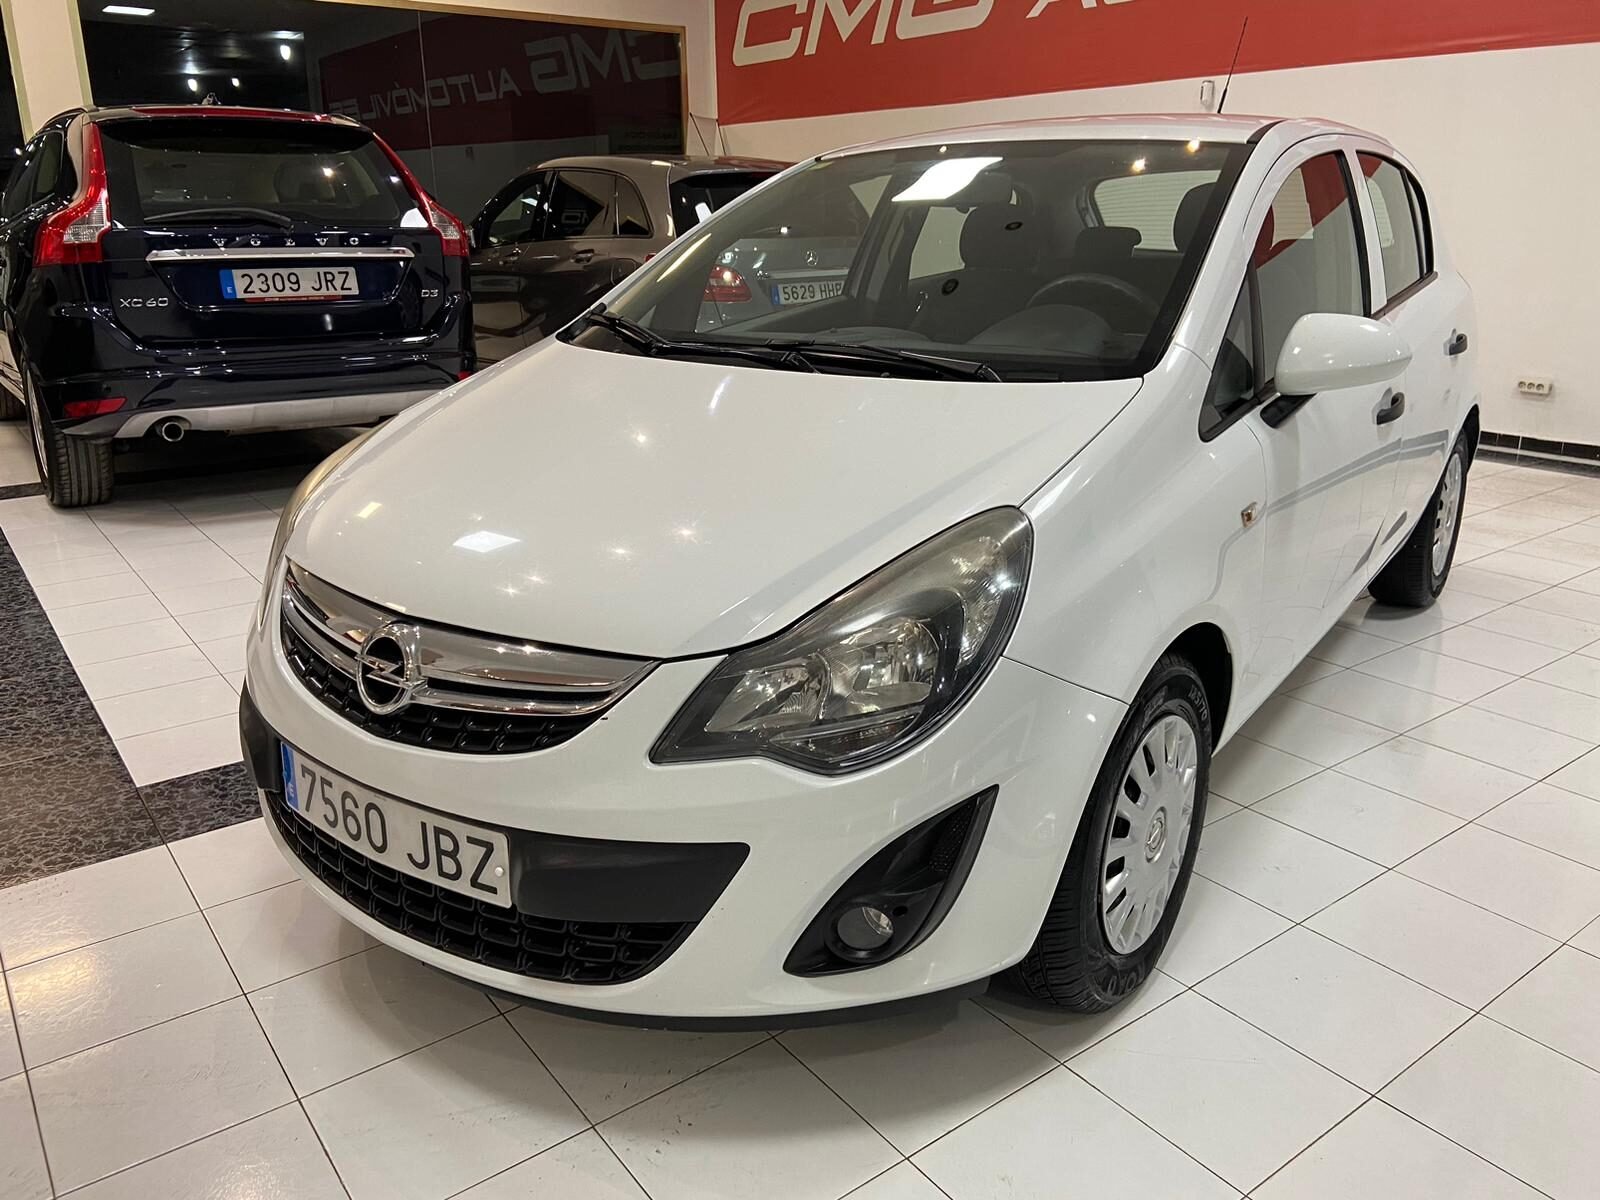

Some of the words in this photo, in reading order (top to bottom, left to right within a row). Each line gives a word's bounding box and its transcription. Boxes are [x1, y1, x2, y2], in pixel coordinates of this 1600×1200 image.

[240, 272, 301, 294] 2309
[311, 270, 353, 292] JRZ
[421, 289, 439, 298] D3
[782, 284, 816, 301] 5629
[301, 763, 388, 854] 7560
[406, 820, 498, 896] JBZ
